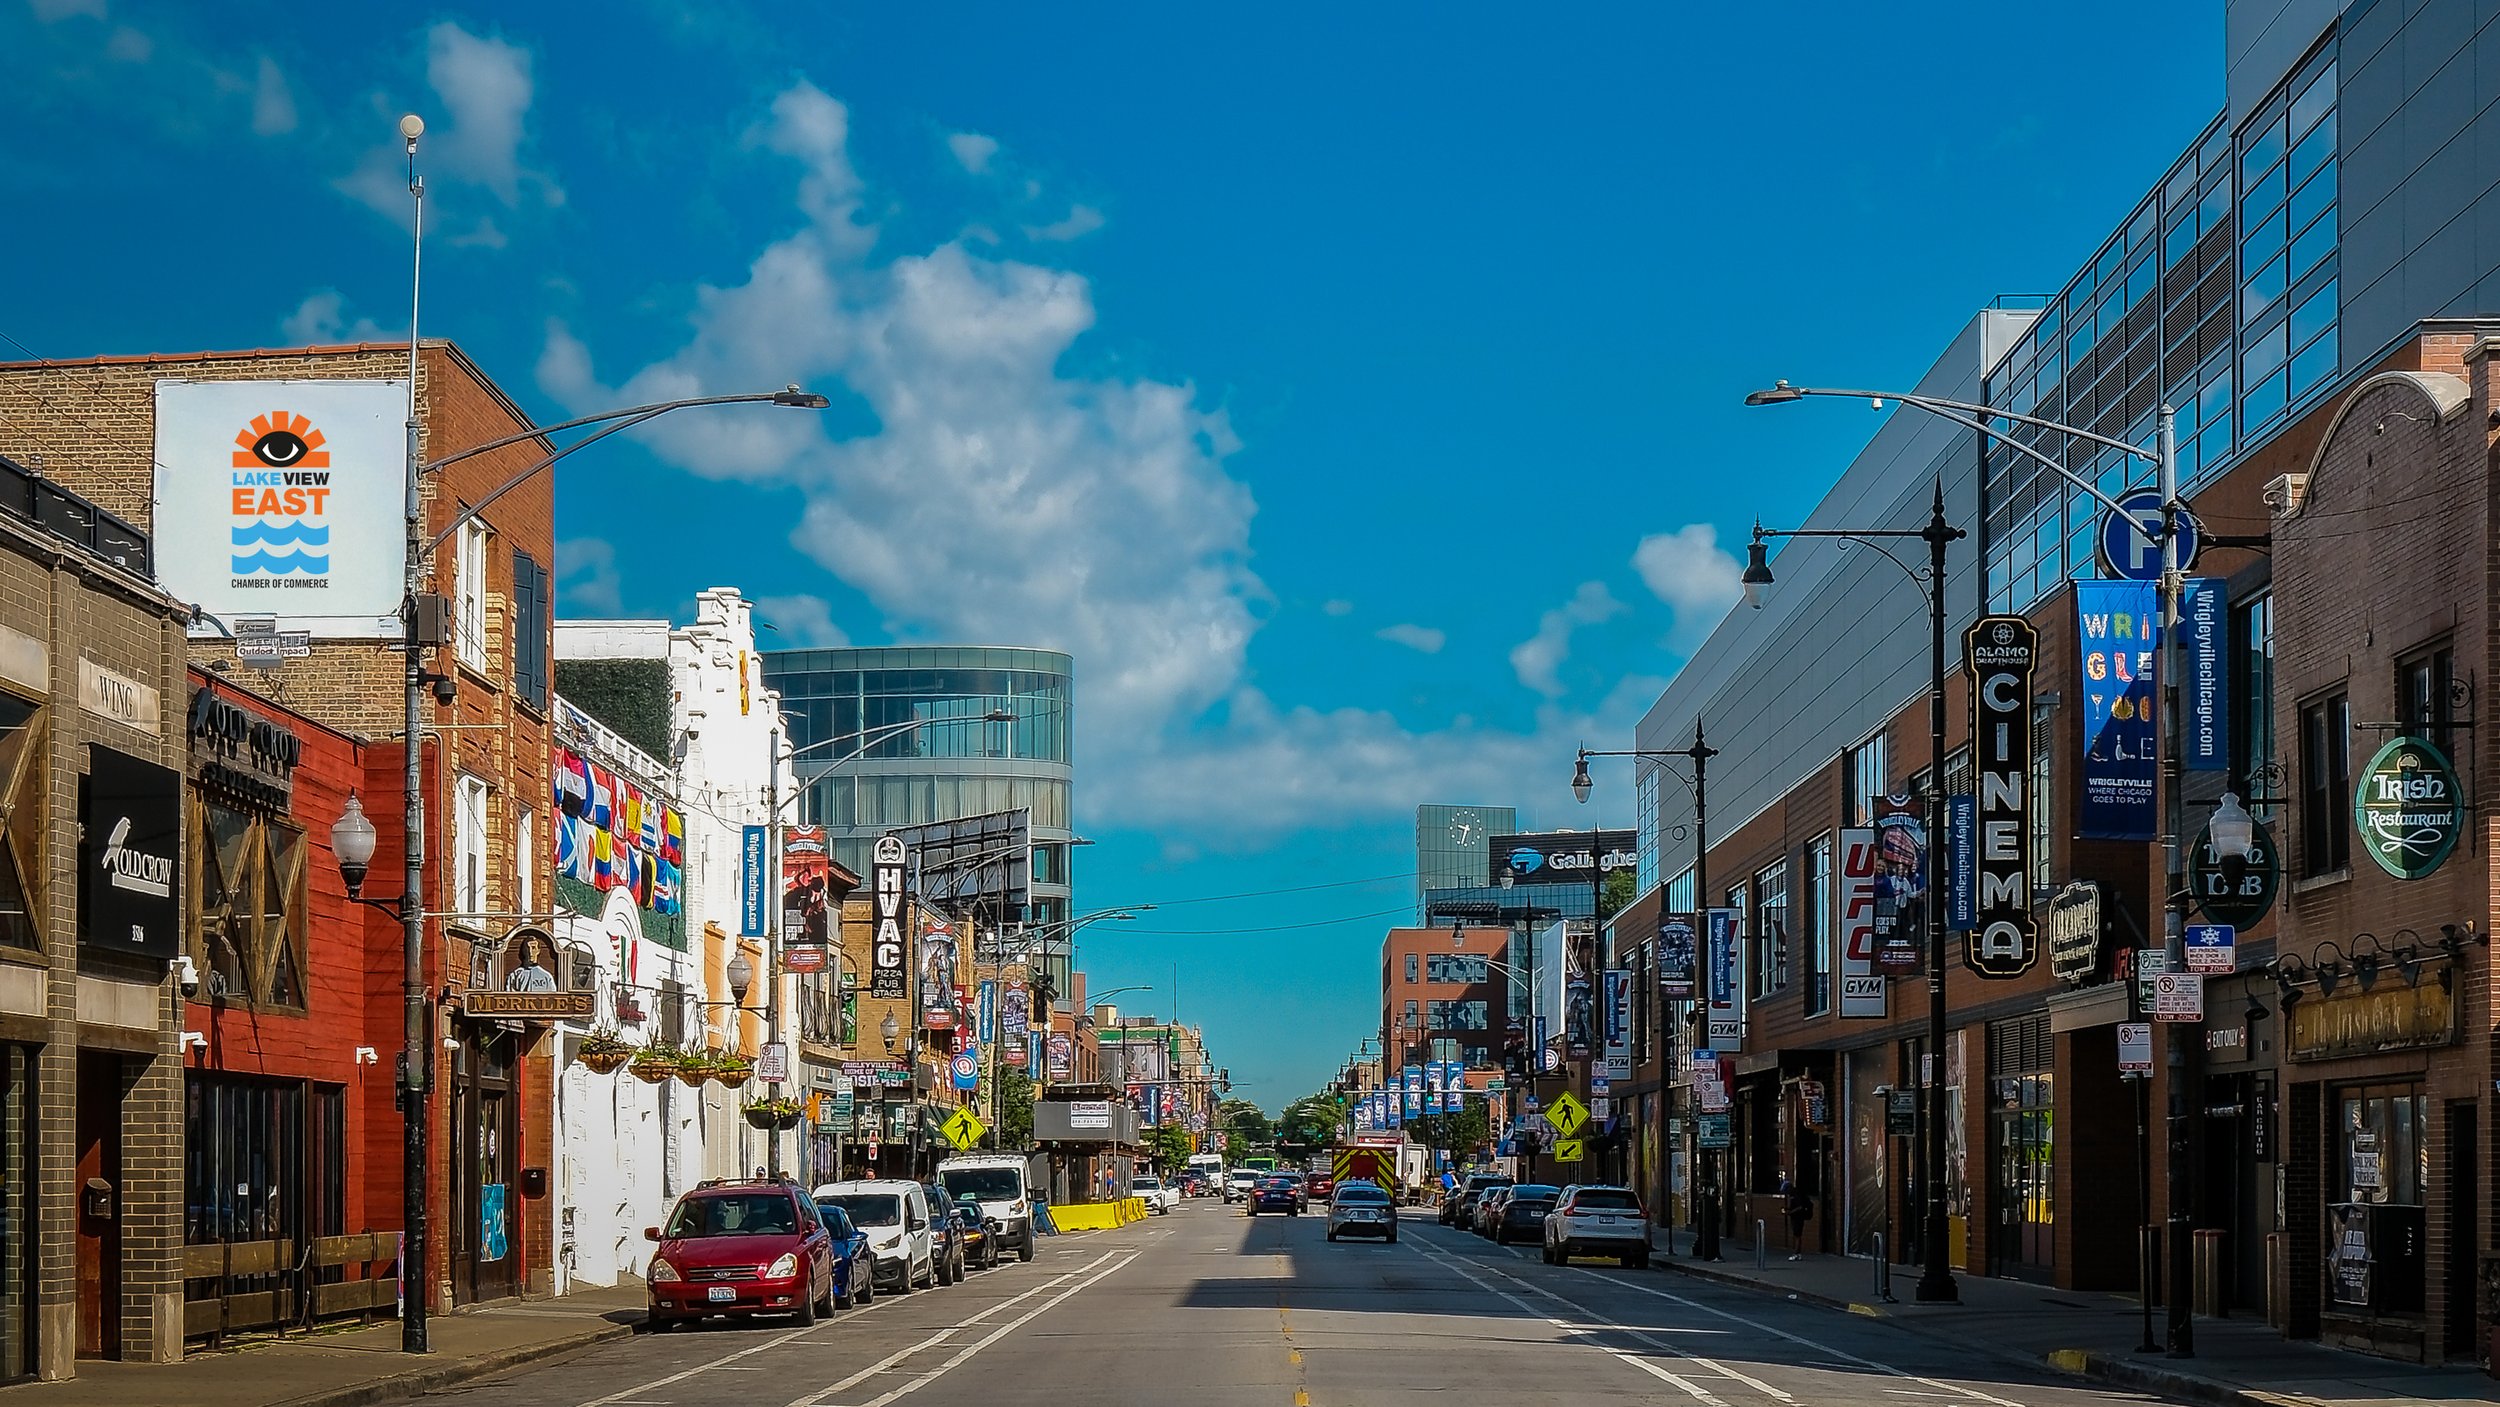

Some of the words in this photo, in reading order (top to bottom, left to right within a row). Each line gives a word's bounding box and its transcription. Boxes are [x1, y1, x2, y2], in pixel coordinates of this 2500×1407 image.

[232, 488, 330, 516] EAST
[231, 579, 270, 589] CHAMBER
[272, 579, 283, 589] OF
[284, 579, 329, 589] COMMERCE
[276, 648, 308, 659] Impact
[1975, 646, 2029, 657] ALAMO
[2195, 590, 2216, 756] Wrigleyvillechicago.com
[99, 674, 133, 717] WING
[207, 700, 249, 743] OLD
[2088, 778, 2153, 787] WRIGLEYVILLE
[2088, 787, 2116, 796] WHERE
[2118, 788, 2152, 796] CHICAGO
[2092, 796, 2114, 804] GOES
[1982, 673, 2022, 959] CINEMA
[120, 848, 142, 877] OLD
[142, 854, 172, 884] CROW
[1956, 803, 1970, 921] Wrigleyvillechicago.com
[1844, 844, 1874, 960] UFC
[877, 868, 902, 968] HVAC
[874, 970, 902, 978] PIZZA
[878, 979, 898, 987] PUB
[1845, 980, 1882, 993] GYM
[470, 993, 589, 1014] MERKLE'S
[1710, 1024, 1738, 1035] GYM
[2212, 1030, 2224, 1048] EXIT
[2225, 1029, 2239, 1047] ONLY
